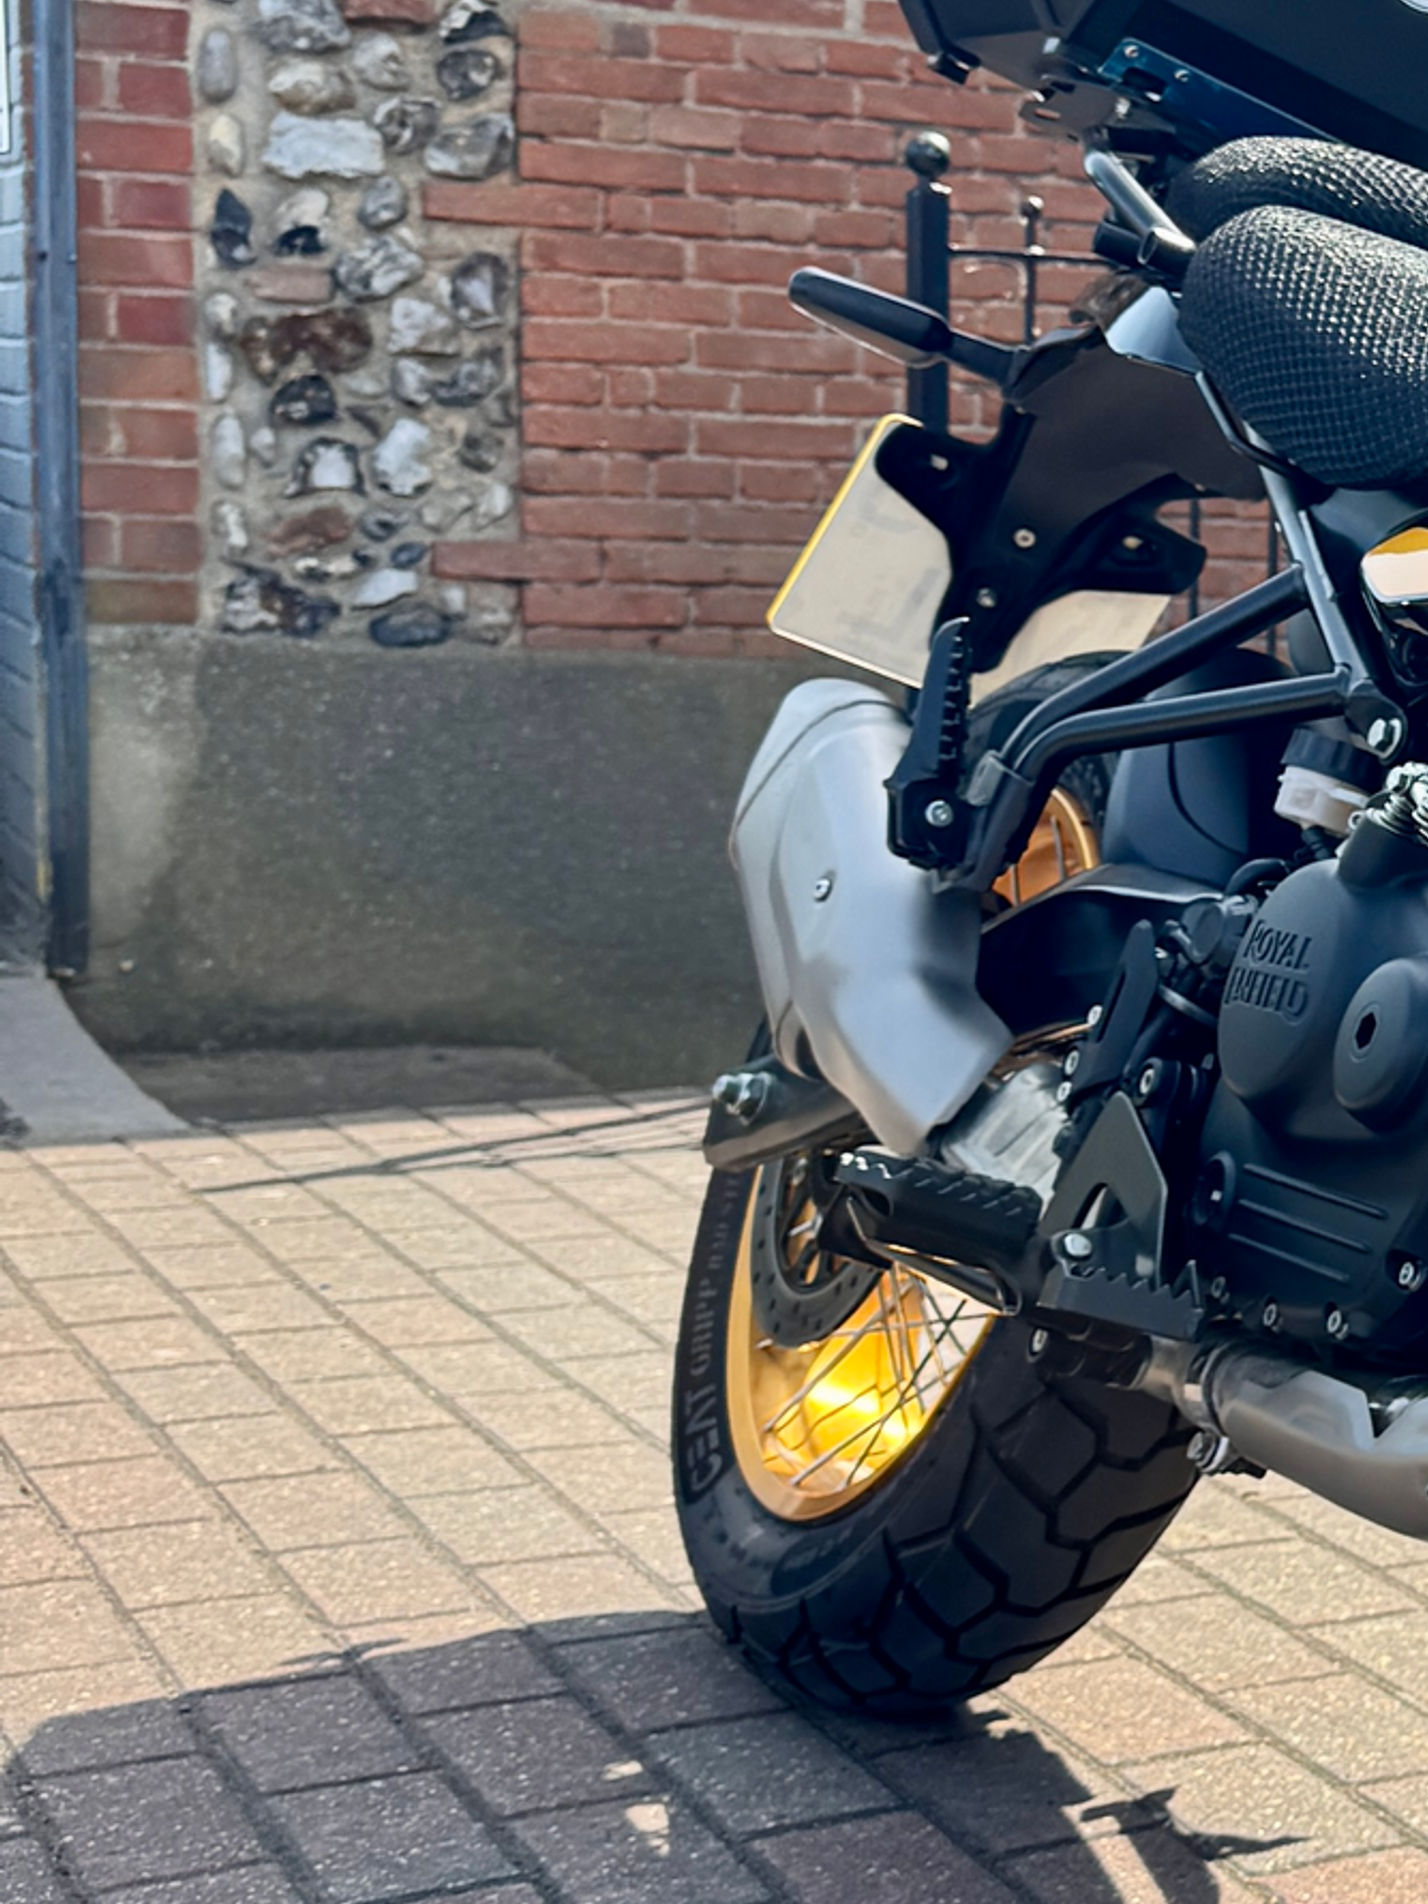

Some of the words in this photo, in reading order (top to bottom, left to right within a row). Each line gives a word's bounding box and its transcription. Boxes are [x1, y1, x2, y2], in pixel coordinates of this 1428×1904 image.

[1243, 919, 1312, 969] ROYAL
[1223, 965, 1309, 1019] ENFIELD
[685, 1382, 724, 1493] CEAT
